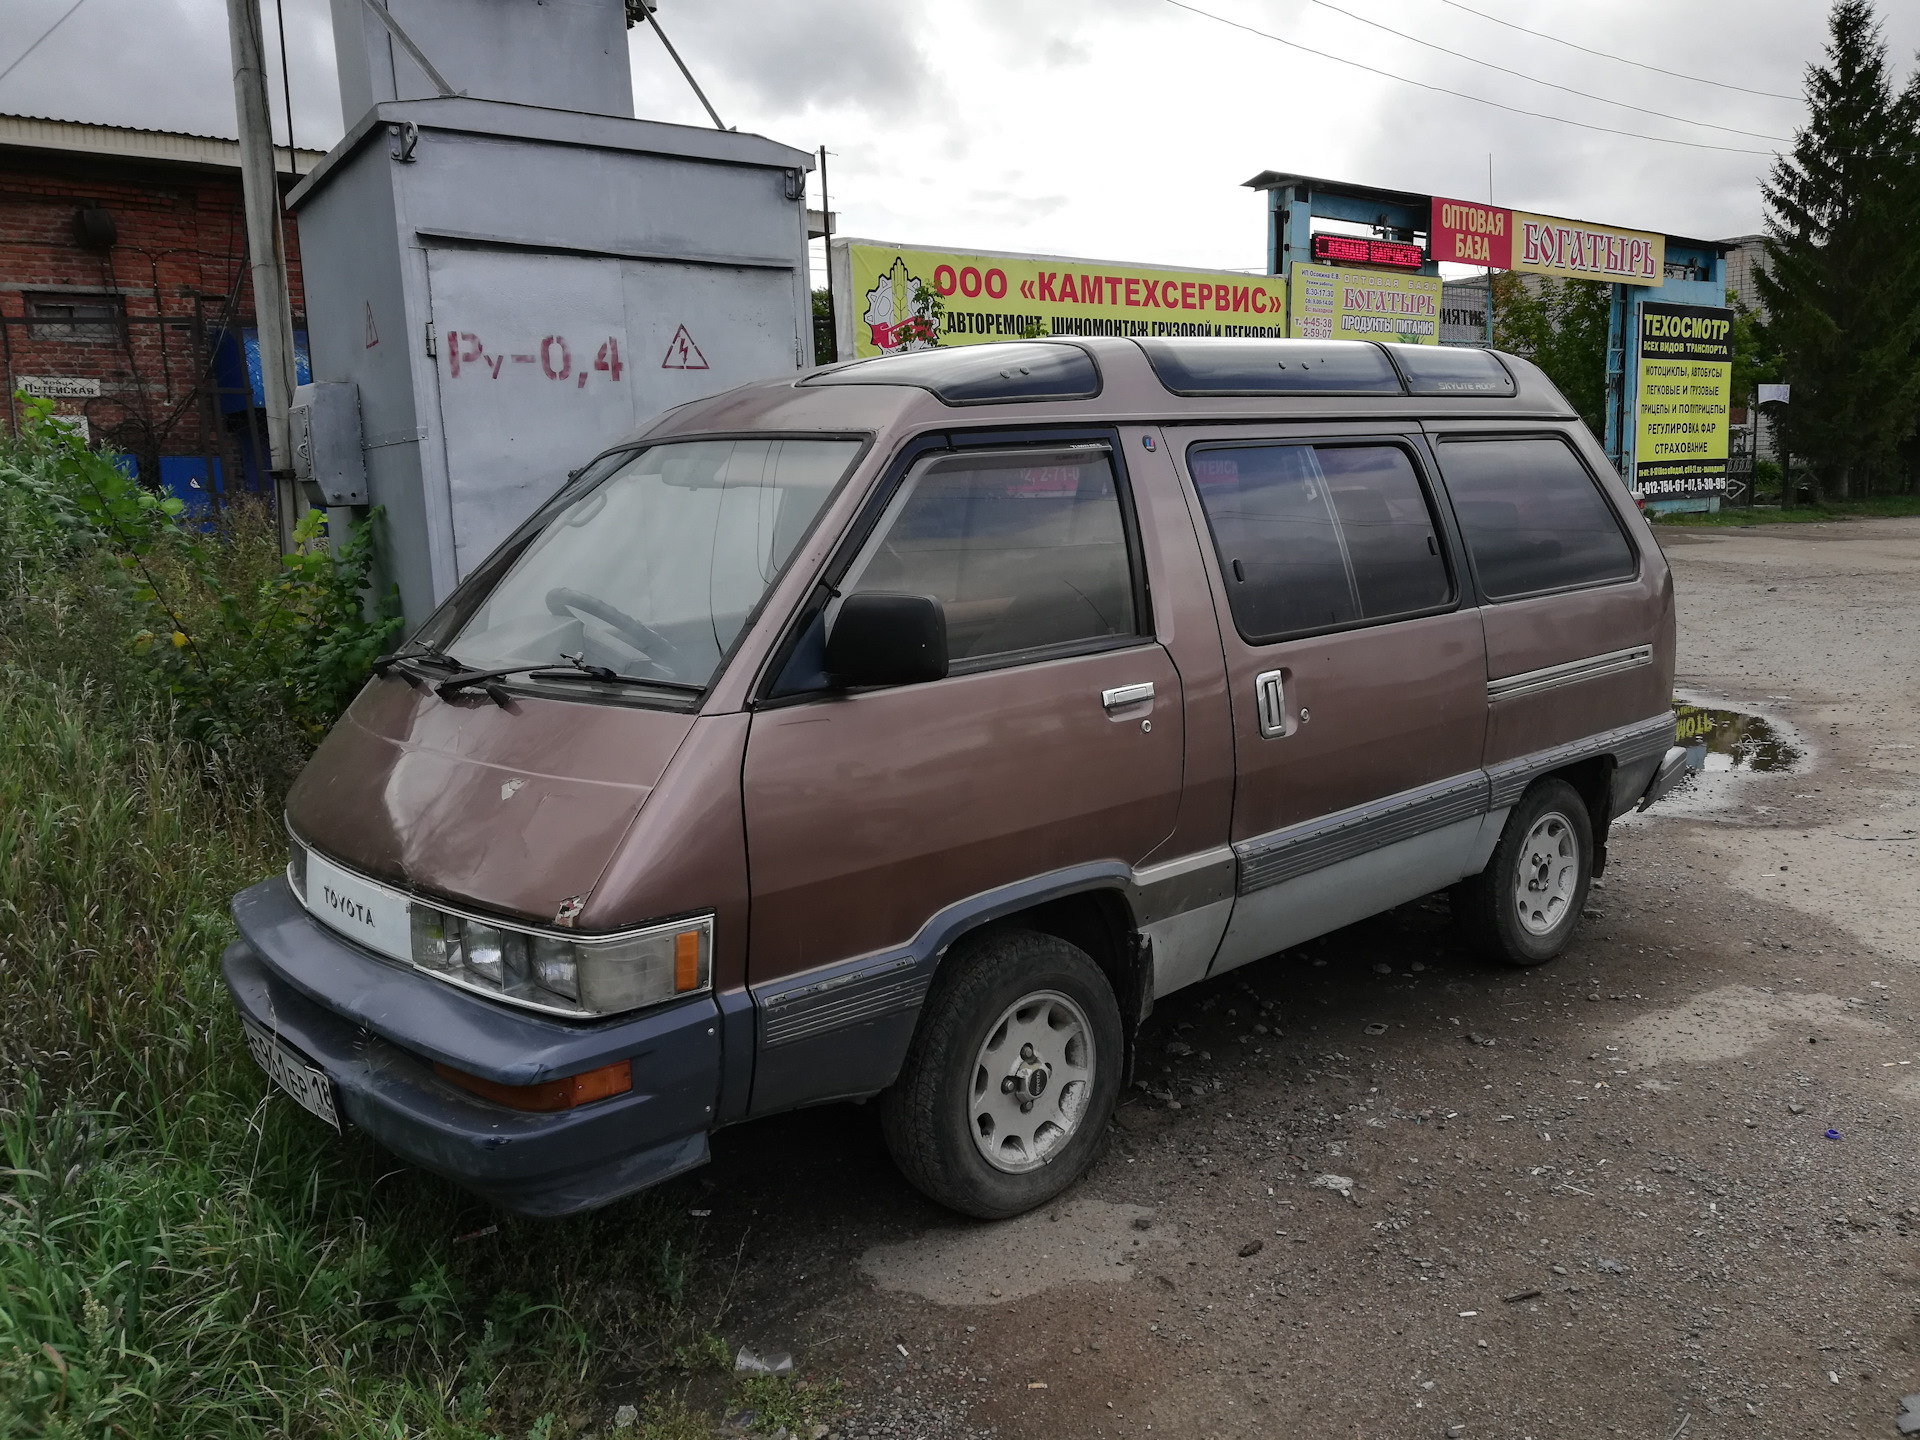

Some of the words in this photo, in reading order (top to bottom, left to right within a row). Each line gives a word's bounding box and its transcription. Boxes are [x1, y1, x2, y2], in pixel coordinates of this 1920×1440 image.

[1441, 203, 1504, 237] ОПТОВАЯ
[1455, 233, 1490, 261] БАЗА
[1522, 220, 1657, 279] БОГАТЫРЬ
[933, 264, 1007, 299] ООО
[1019, 271, 1282, 314] «КАМТЕХСЕРВИС»
[1344, 274, 1399, 288] ОПТОВАЯ
[1408, 280, 1437, 291] БАЗА
[1343, 287, 1436, 316] БОГАТЫРЬ
[947, 312, 1042, 336] АВТОРЕМОНТ
[1052, 316, 1148, 337] ШИНОМОНТАЖ
[1303, 316, 1333, 328] 4-45-38
[1341, 315, 1393, 333] ПРОДУКТЫ
[1396, 318, 1434, 335] ПИТАНИЯ
[1644, 314, 1730, 341] ТЕХОСМОТР
[1303, 327, 1332, 338] 2-59-07
[1643, 341, 1659, 352] ВСЕХ
[1660, 342, 1684, 353] ВИДОВ
[1686, 343, 1728, 355] ТРАНСПОРТА
[1691, 366, 1722, 378] АВТОБУСЫ
[1646, 385, 1680, 395] ЛЕГКОВЫЕ
[1683, 385, 1688, 395] И
[1690, 386, 1719, 396] ГРУЗОВЫЕ
[1641, 403, 1670, 416] ПРИЦЕПЫ
[1672, 404, 1677, 414] И
[1648, 422, 1699, 435] РЕГУЛИРОВКА
[1701, 422, 1716, 434] ФАР
[1654, 442, 1708, 455] СТРАХОВАНИЕ
[323, 885, 375, 928] TOYOTA
